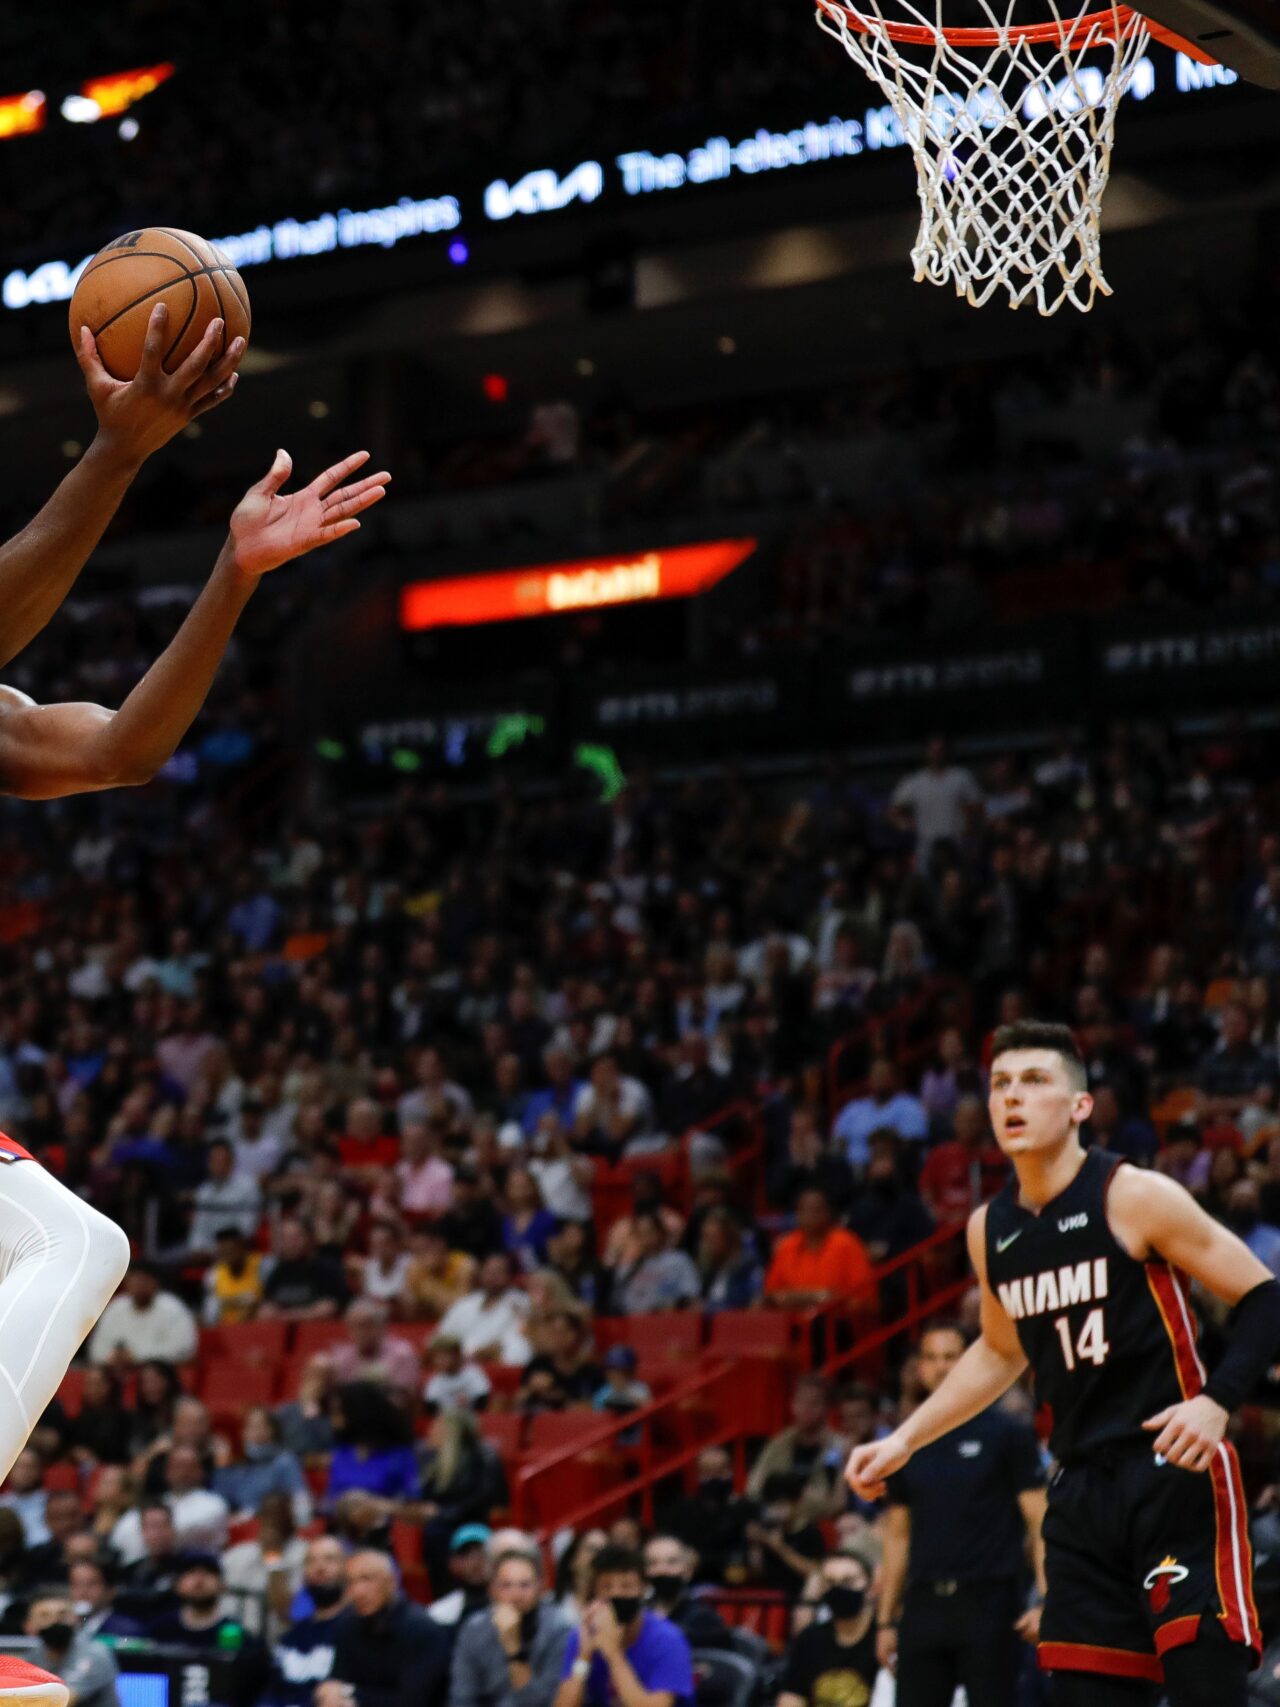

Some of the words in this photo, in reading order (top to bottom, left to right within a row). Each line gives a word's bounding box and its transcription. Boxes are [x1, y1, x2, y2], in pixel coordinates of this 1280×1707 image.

[616, 150, 686, 195] The
[686, 115, 863, 183] all-electric
[272, 212, 337, 259] that
[337, 195, 461, 249] inspires
[1057, 1211, 1089, 1233] UKG
[997, 1256, 1109, 1320] MIAMI
[1054, 1306, 1110, 1371] 14
